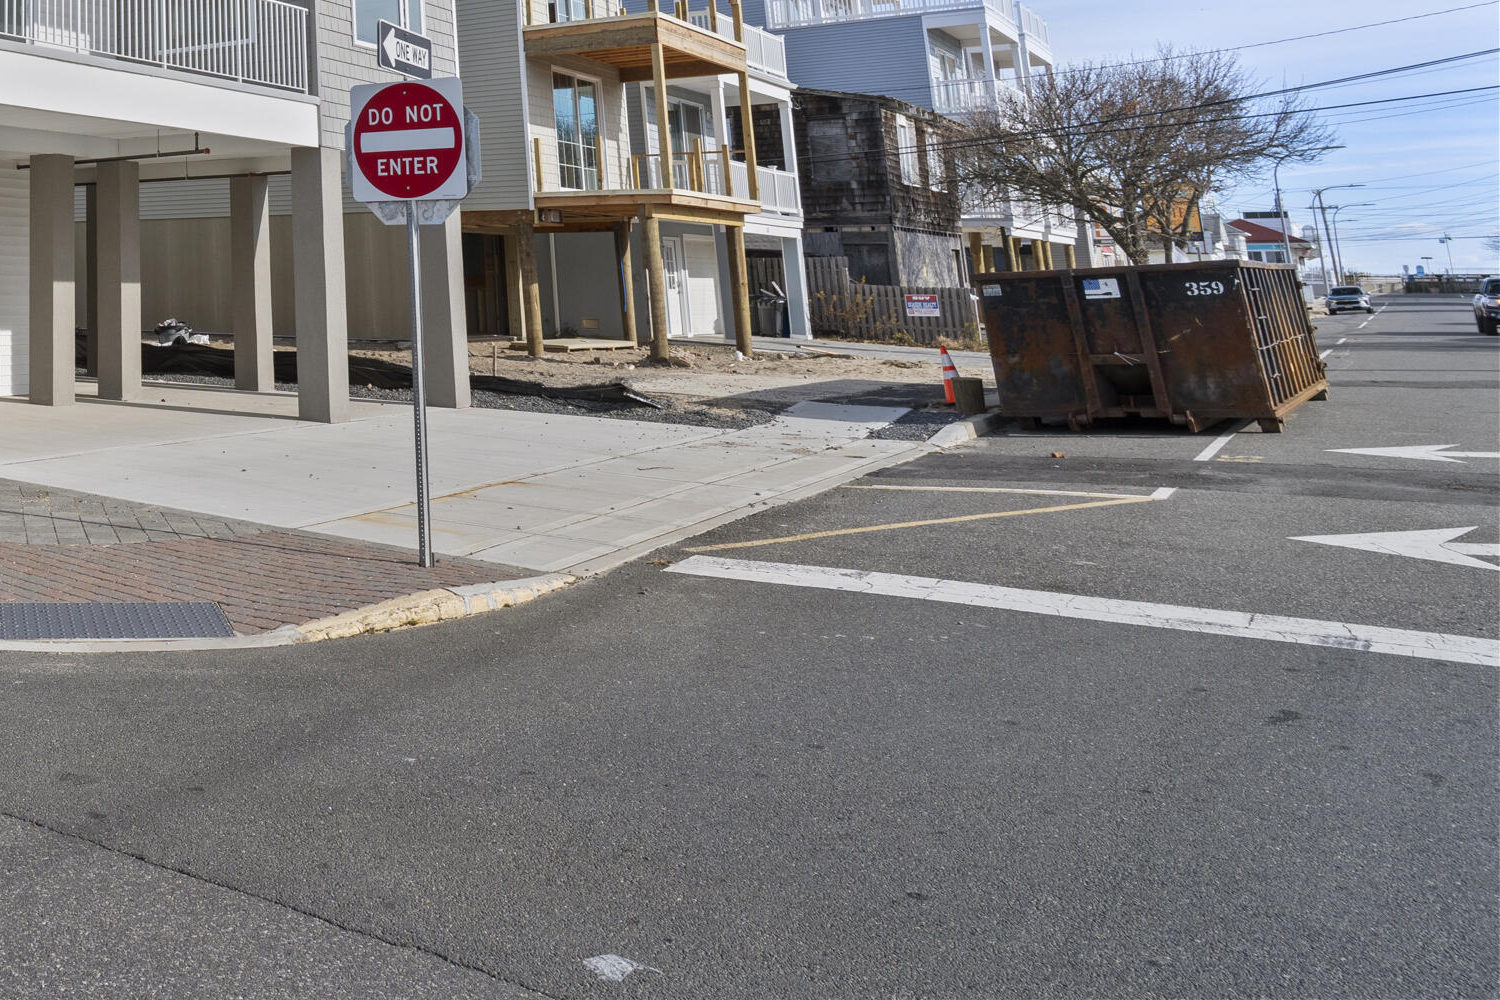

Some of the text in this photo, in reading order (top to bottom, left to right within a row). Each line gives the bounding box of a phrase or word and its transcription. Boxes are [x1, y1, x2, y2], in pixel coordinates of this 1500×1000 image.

[395, 40, 427, 66] ONE WAY
[368, 103, 444, 126] DO NOT
[377, 156, 439, 177] ENTER
[1185, 281, 1225, 296] 359
